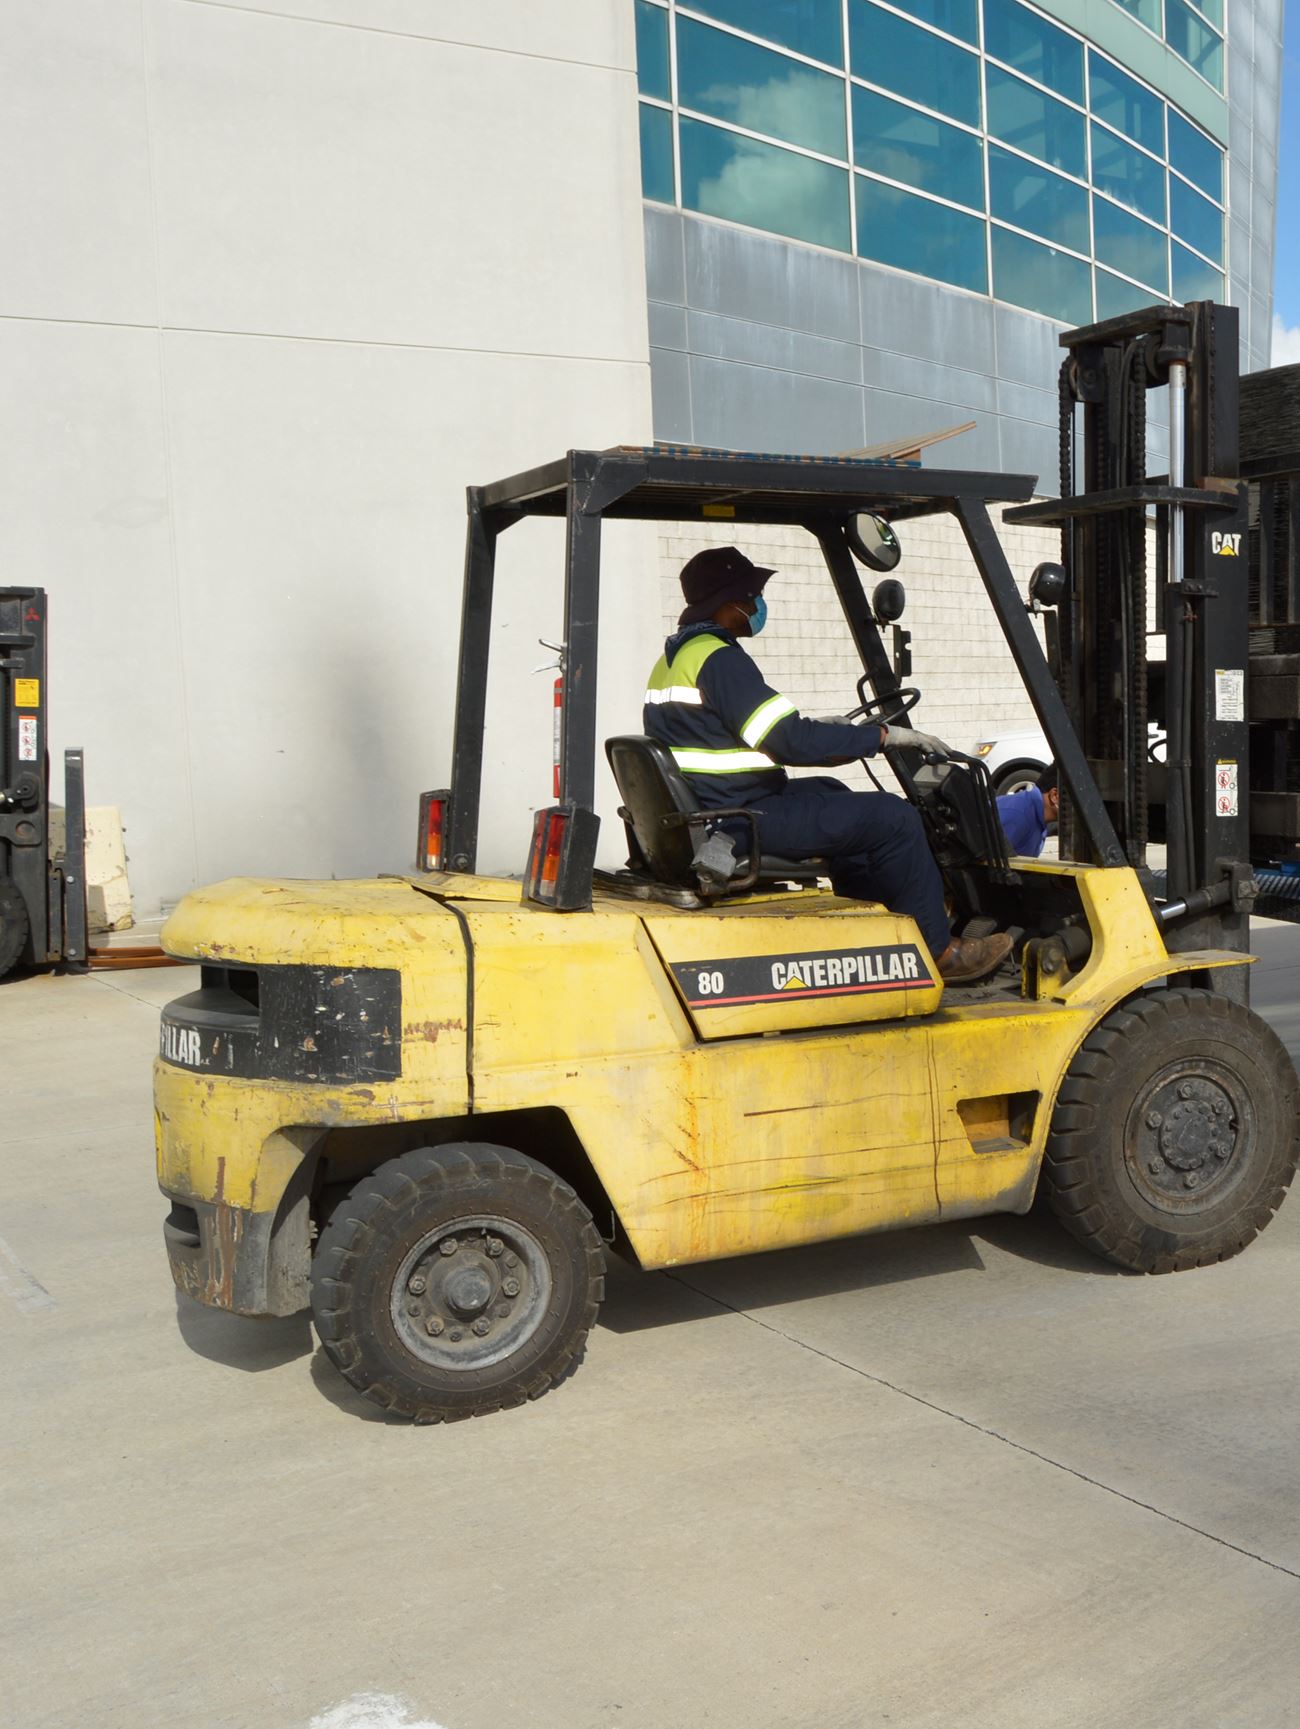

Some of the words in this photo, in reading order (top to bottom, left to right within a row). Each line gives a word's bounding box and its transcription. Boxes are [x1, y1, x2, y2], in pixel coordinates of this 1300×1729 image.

[1211, 531, 1241, 556] CAT
[698, 972, 724, 995] 80
[771, 952, 918, 990] CATERPILLAR
